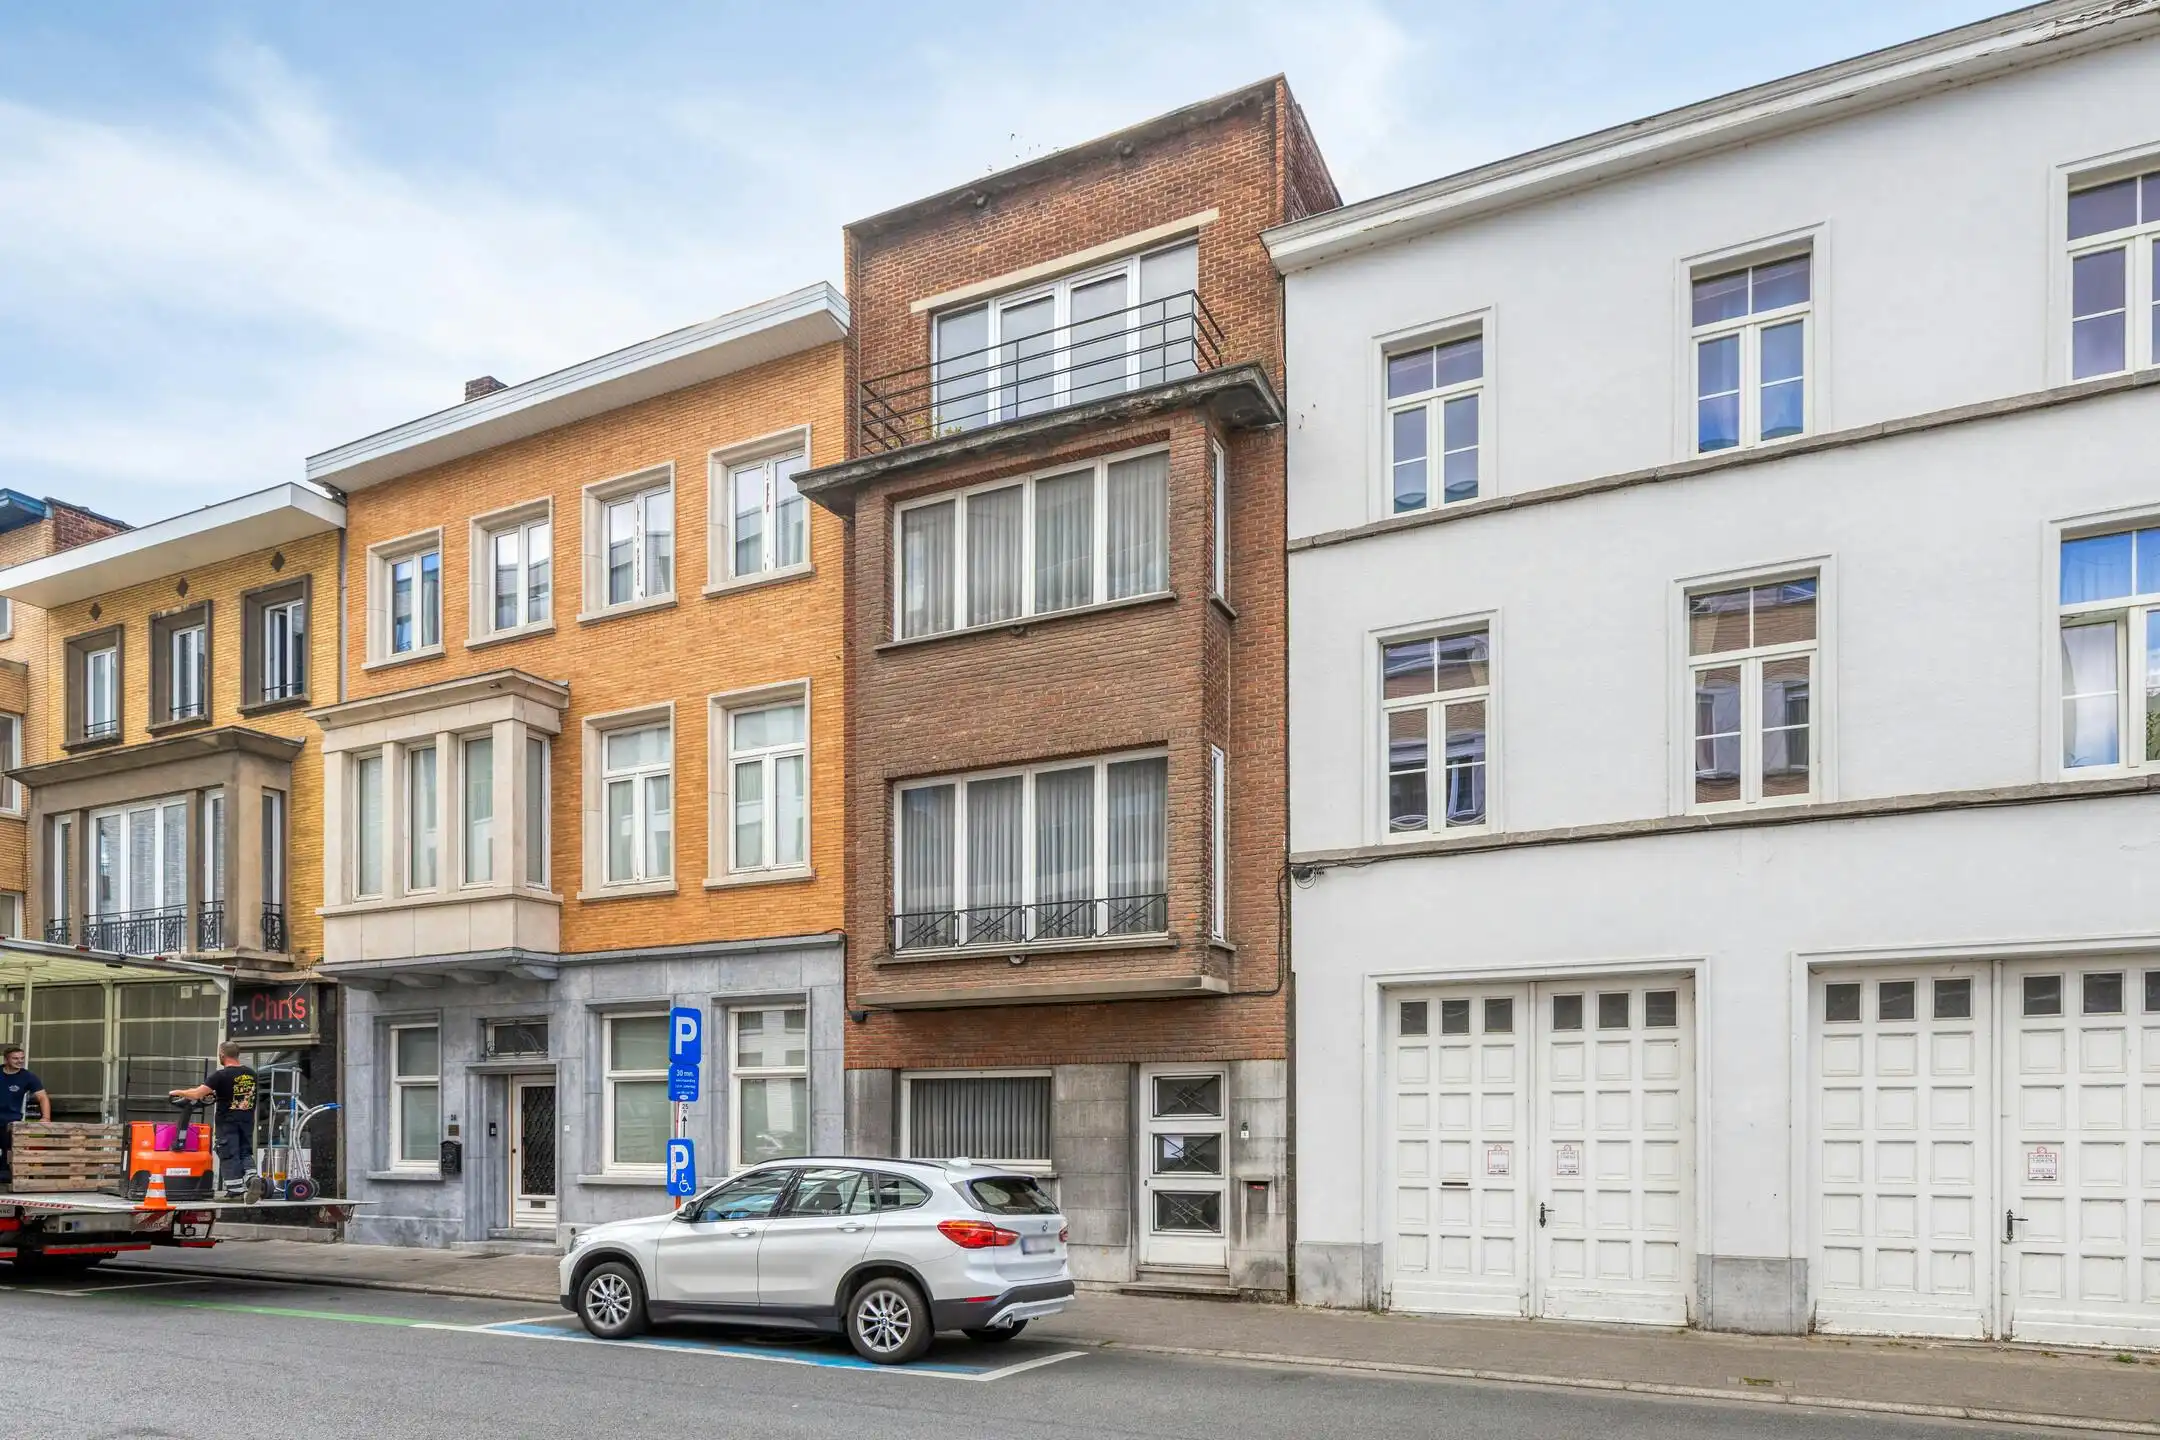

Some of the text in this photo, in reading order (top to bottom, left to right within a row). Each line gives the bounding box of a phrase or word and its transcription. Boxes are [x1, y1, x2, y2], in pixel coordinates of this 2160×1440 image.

[252, 991, 306, 1021] Chris
[675, 1016, 697, 1055] P
[676, 1069, 683, 1077] 30
[670, 1144, 689, 1182] P
